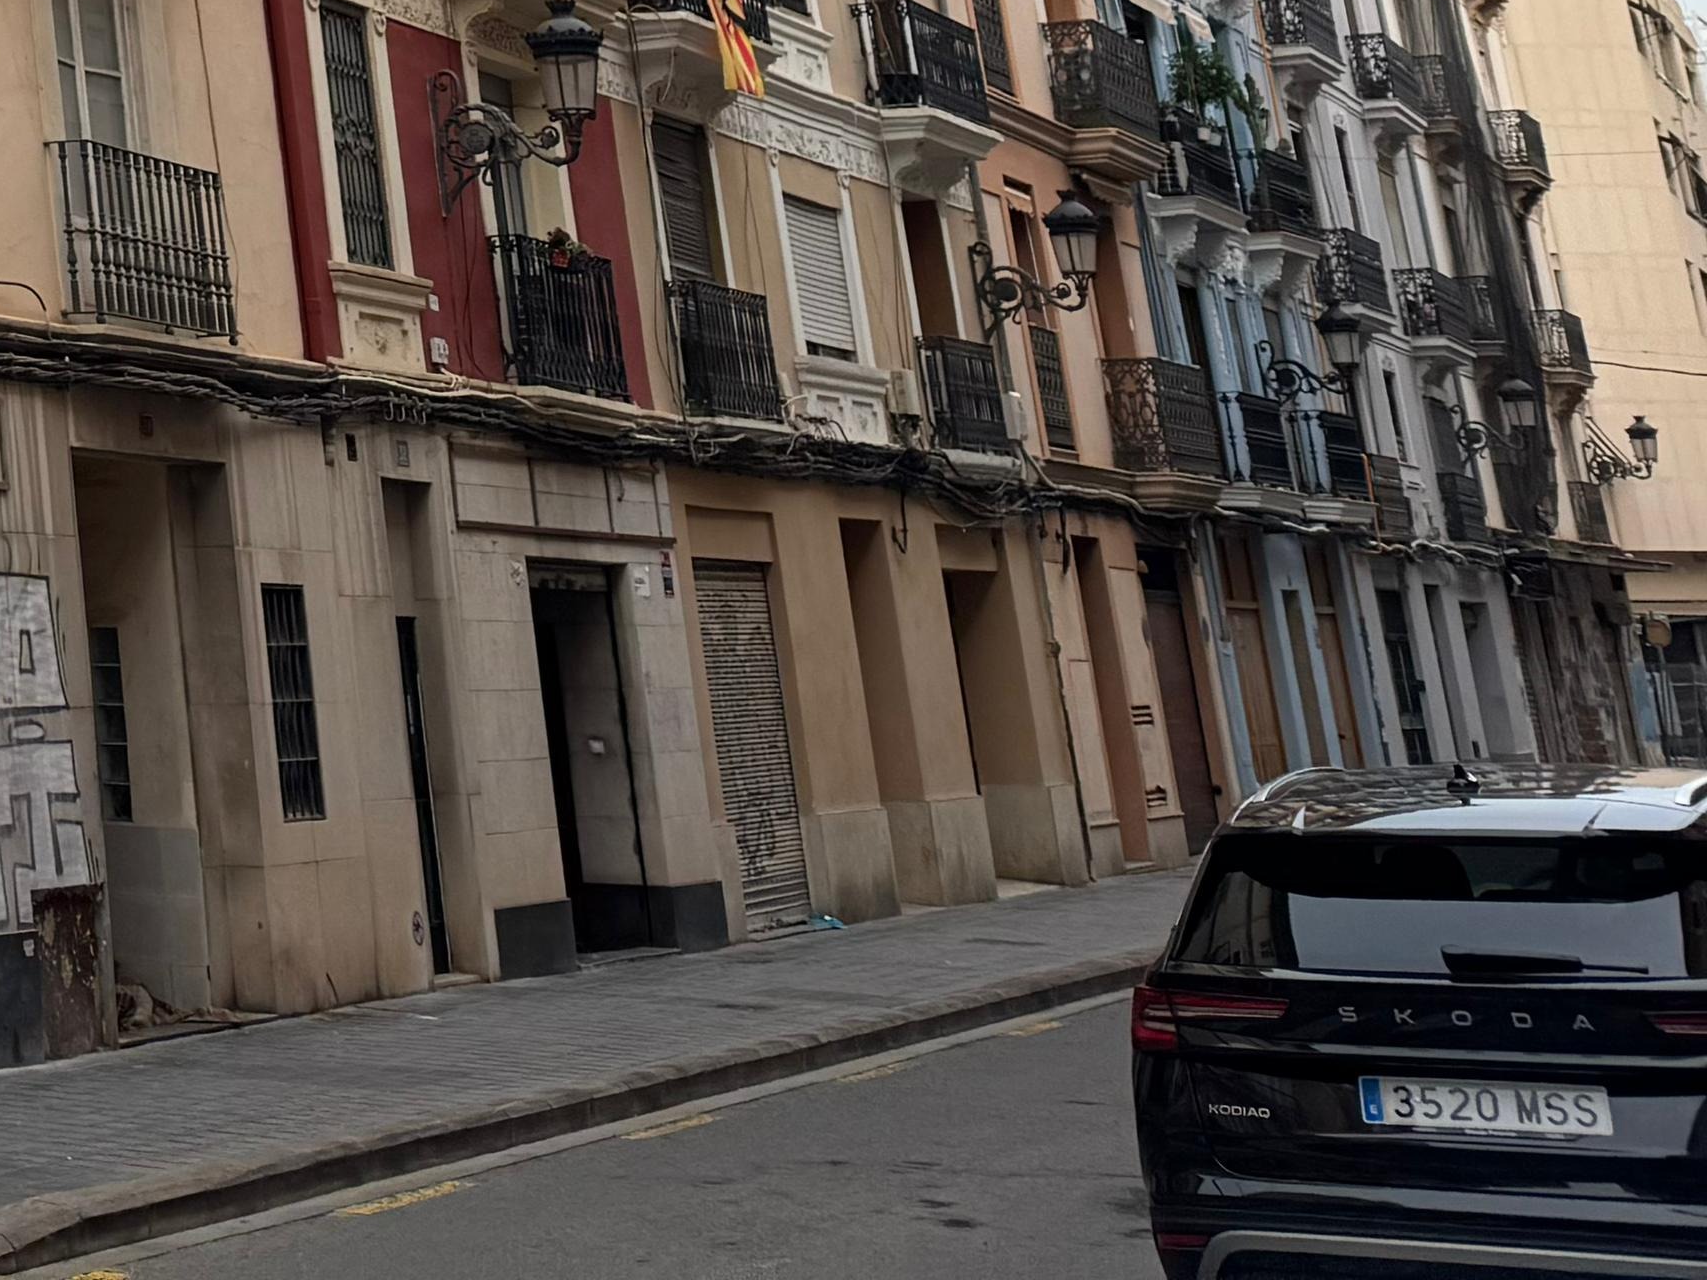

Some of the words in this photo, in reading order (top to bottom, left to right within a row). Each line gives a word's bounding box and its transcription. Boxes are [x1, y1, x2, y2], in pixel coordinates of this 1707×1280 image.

[1208, 1103, 1271, 1119] KODIAQ
[1392, 1085, 1500, 1124] 3520
[1513, 1089, 1599, 1128] MSS
